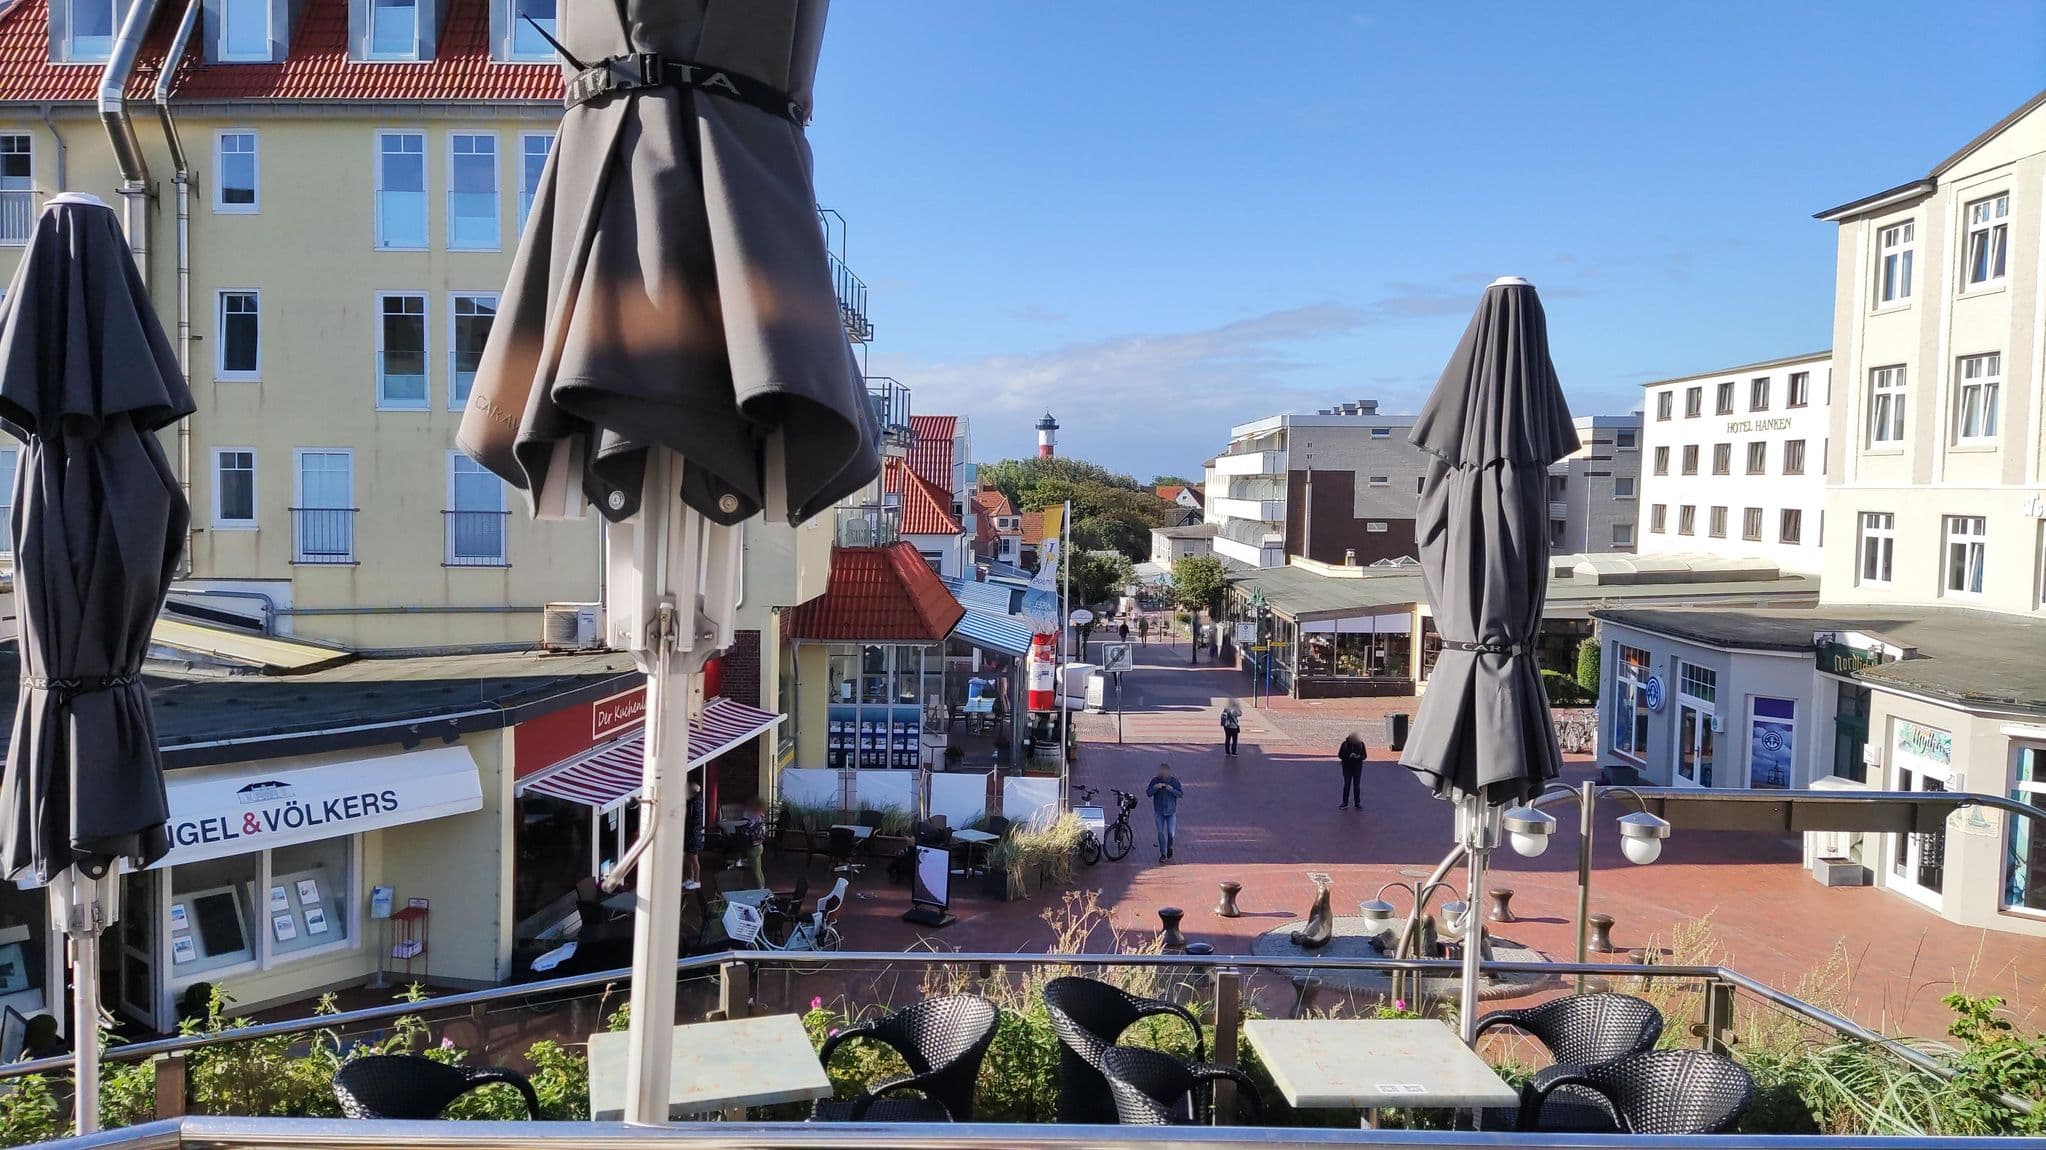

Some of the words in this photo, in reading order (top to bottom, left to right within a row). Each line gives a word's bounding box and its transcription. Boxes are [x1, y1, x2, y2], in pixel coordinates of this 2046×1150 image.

[1726, 421, 1753, 434] HOTEL
[1755, 417, 1792, 432] HANKEN
[598, 711, 613, 728] Der
[262, 790, 399, 832] VÖLKERS
